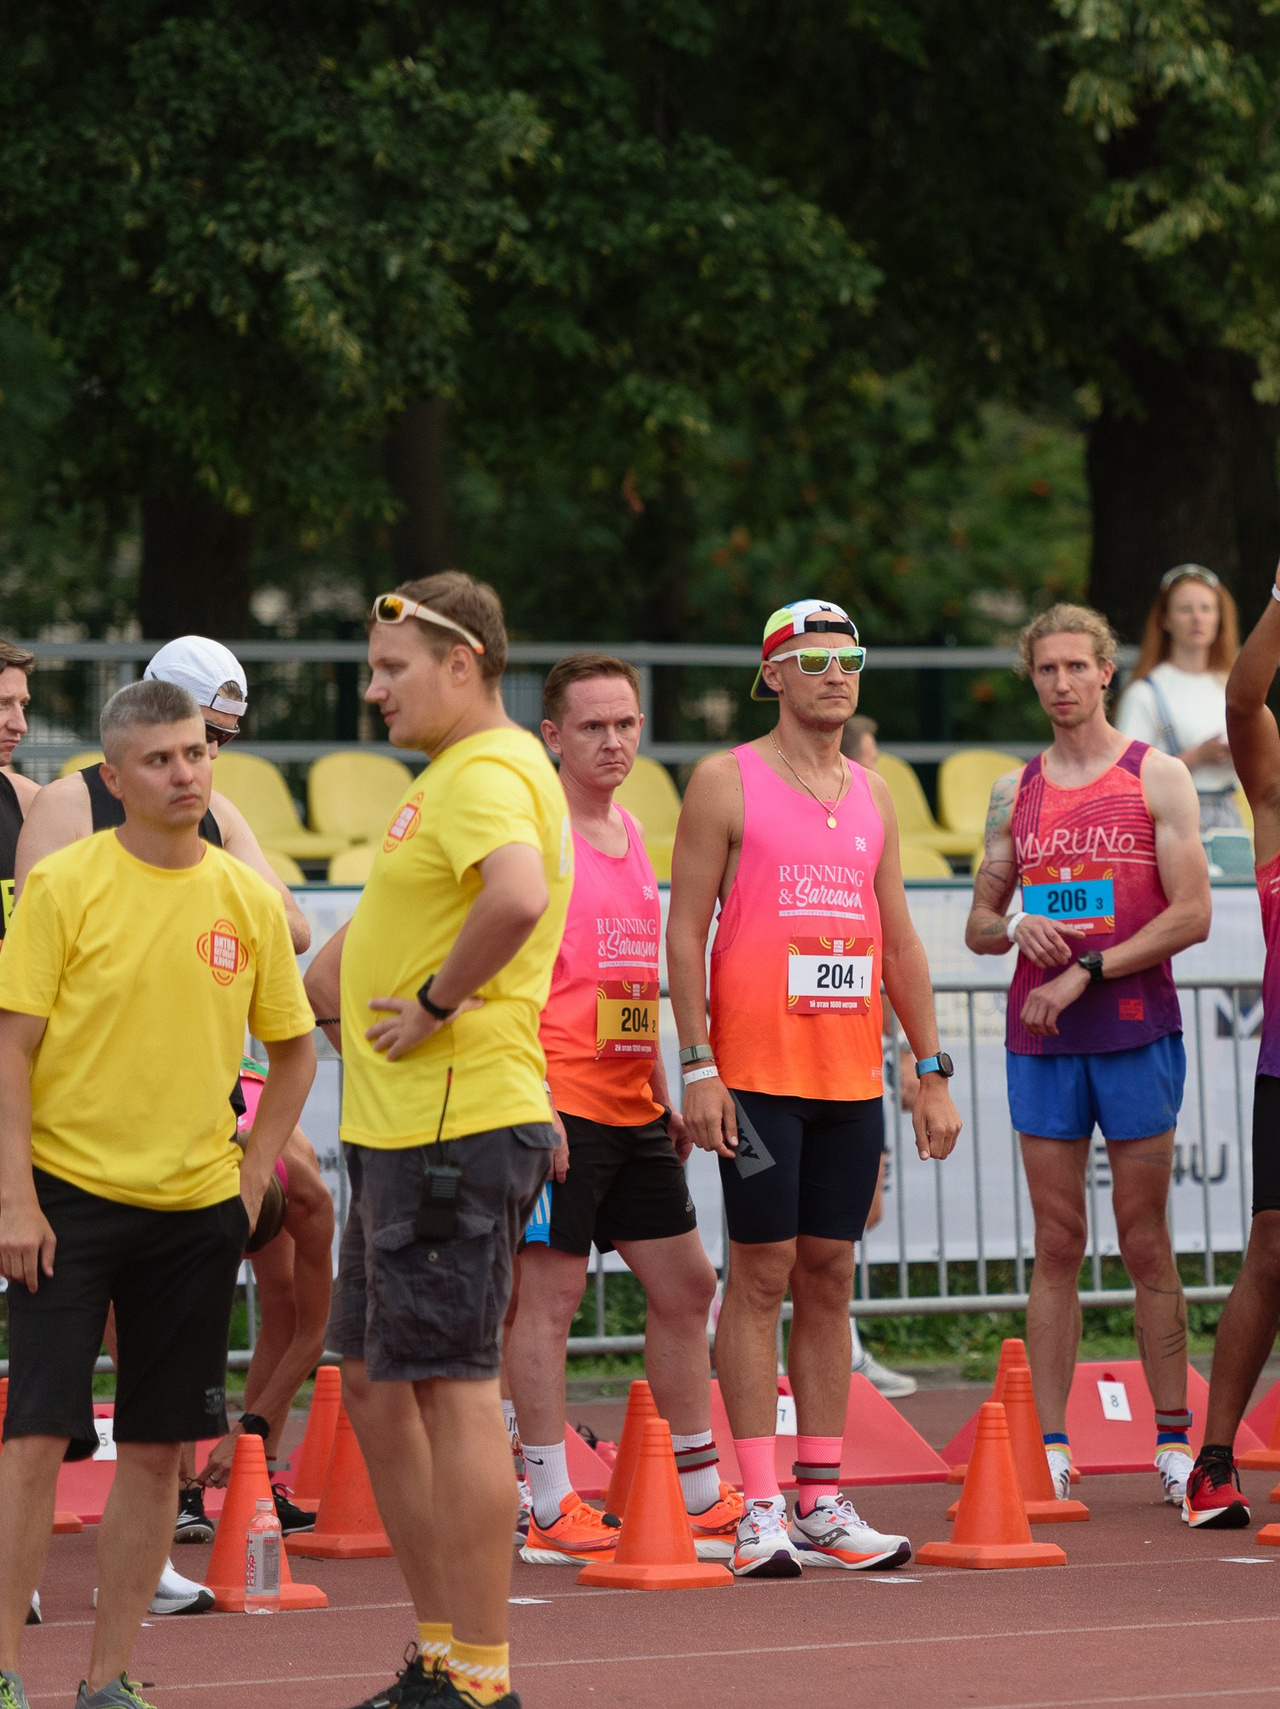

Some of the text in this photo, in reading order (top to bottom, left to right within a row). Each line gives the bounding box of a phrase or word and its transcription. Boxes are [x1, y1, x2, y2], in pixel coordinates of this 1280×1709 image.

[779, 865, 864, 887] RUNNING
[779, 876, 862, 909] & Sarcasm
[1047, 888, 1104, 913] 206 3
[596, 917, 657, 935] RUNNING
[598, 930, 657, 959] & Sarcasm
[817, 963, 864, 989] 204 1
[621, 1007, 656, 1033] 204 2
[1110, 1395, 1119, 1408] 8
[779, 1409, 786, 1422] 7
[99, 1433, 108, 1447] 5
